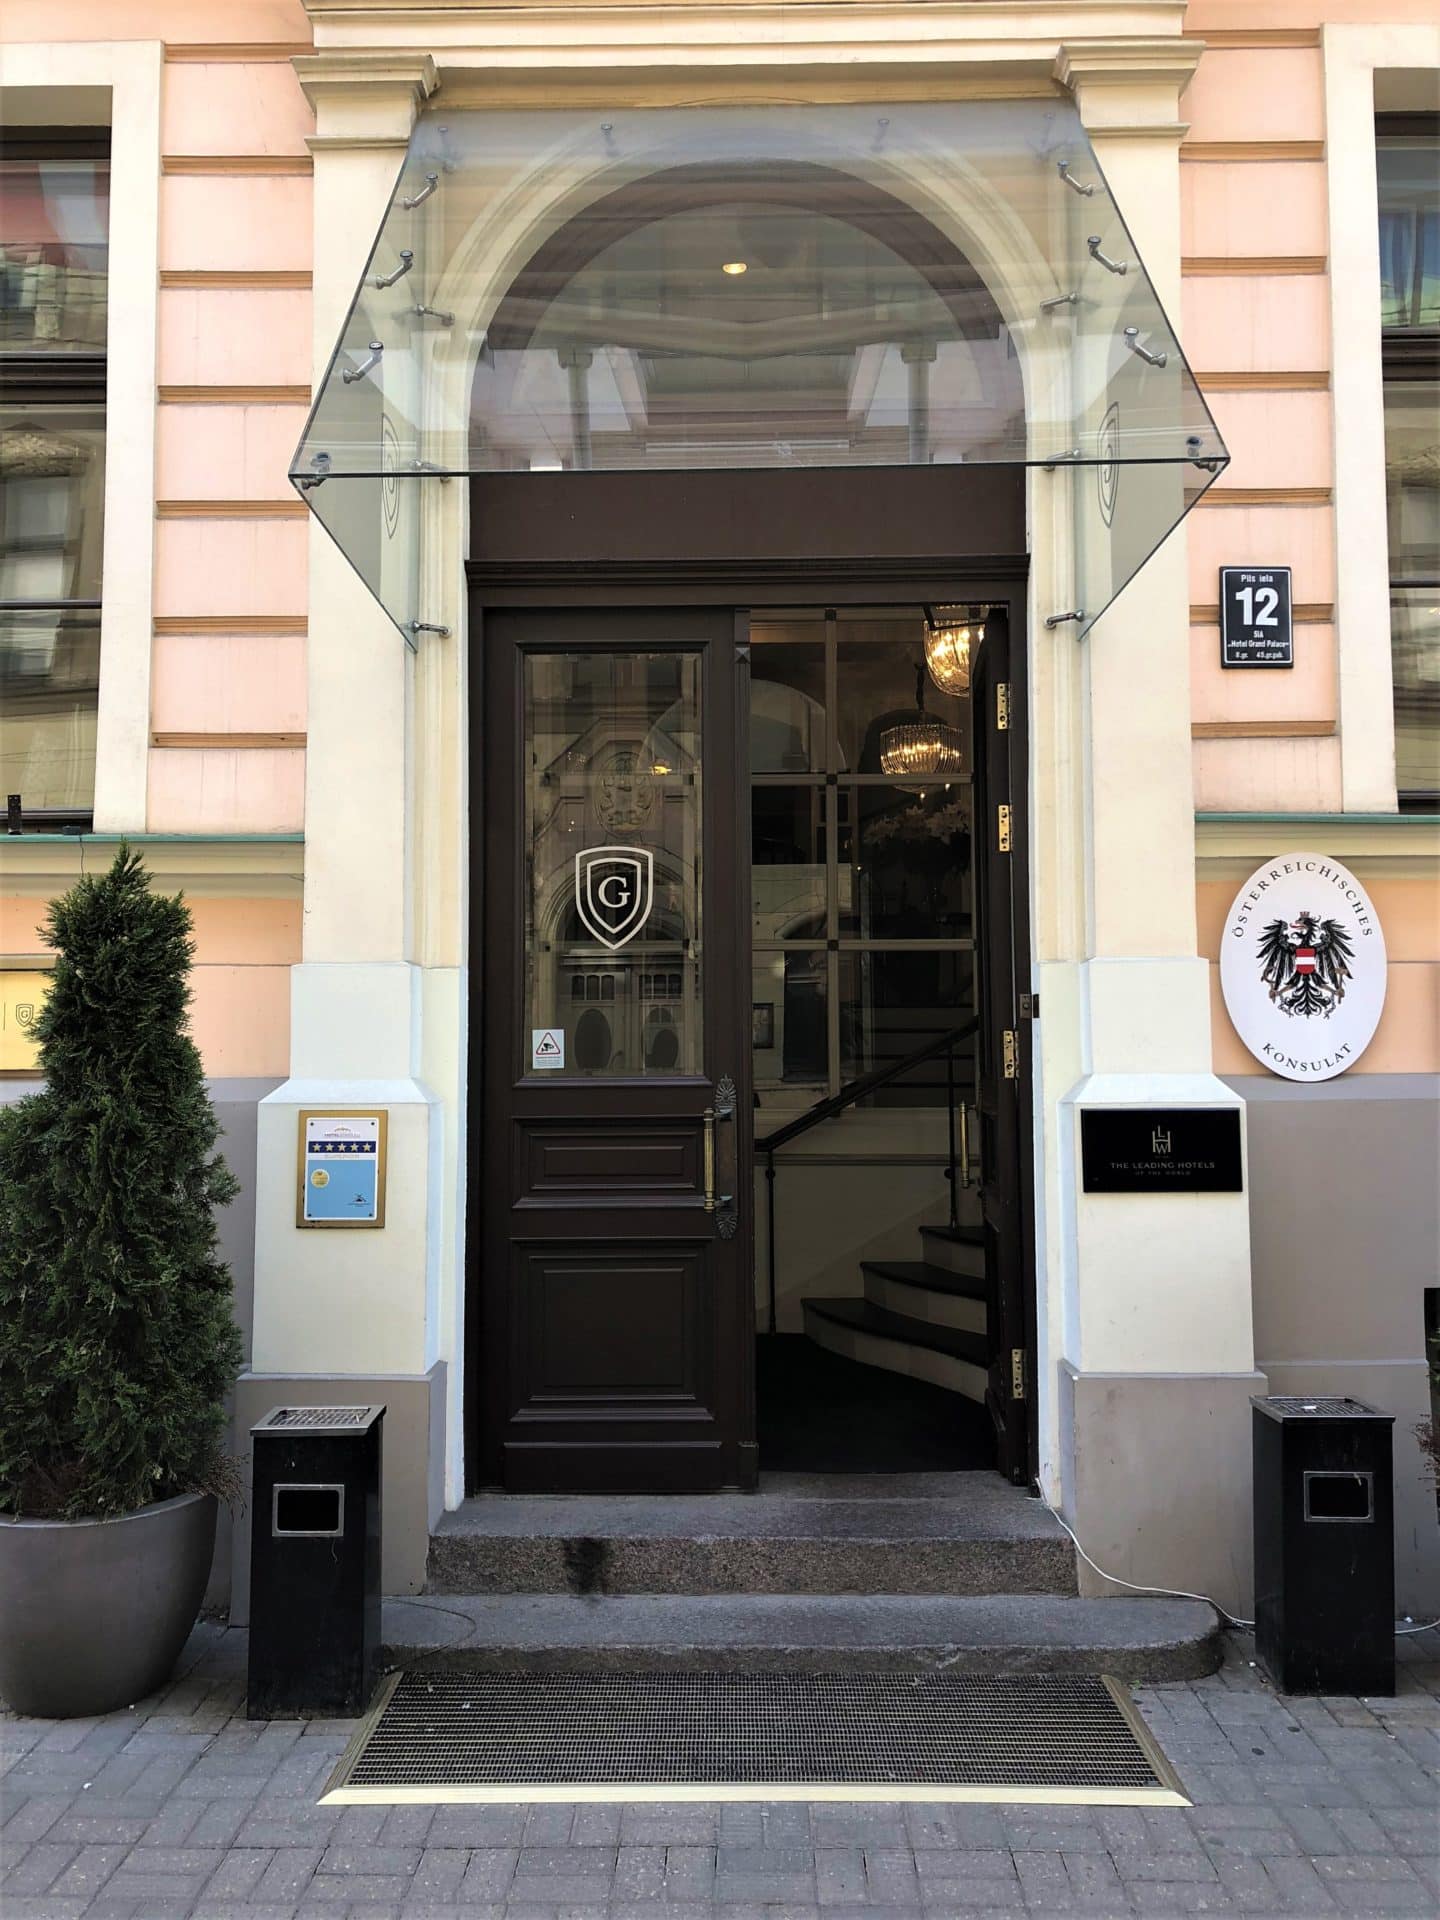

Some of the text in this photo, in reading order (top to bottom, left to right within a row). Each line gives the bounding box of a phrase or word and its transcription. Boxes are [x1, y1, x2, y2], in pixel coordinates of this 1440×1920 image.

[1241, 574, 1256, 583] Pils
[1235, 587, 1278, 626] 12
[1253, 630, 1264, 638] SIA
[1248, 640, 1266, 648] Grand
[598, 876, 631, 908] G
[1232, 862, 1373, 938] ÖSTERREICHISCHES
[1262, 1042, 1352, 1072] KONSULAT
[1132, 1161, 1175, 1169] LEADING
[1178, 1161, 1215, 1169] HOTELS
